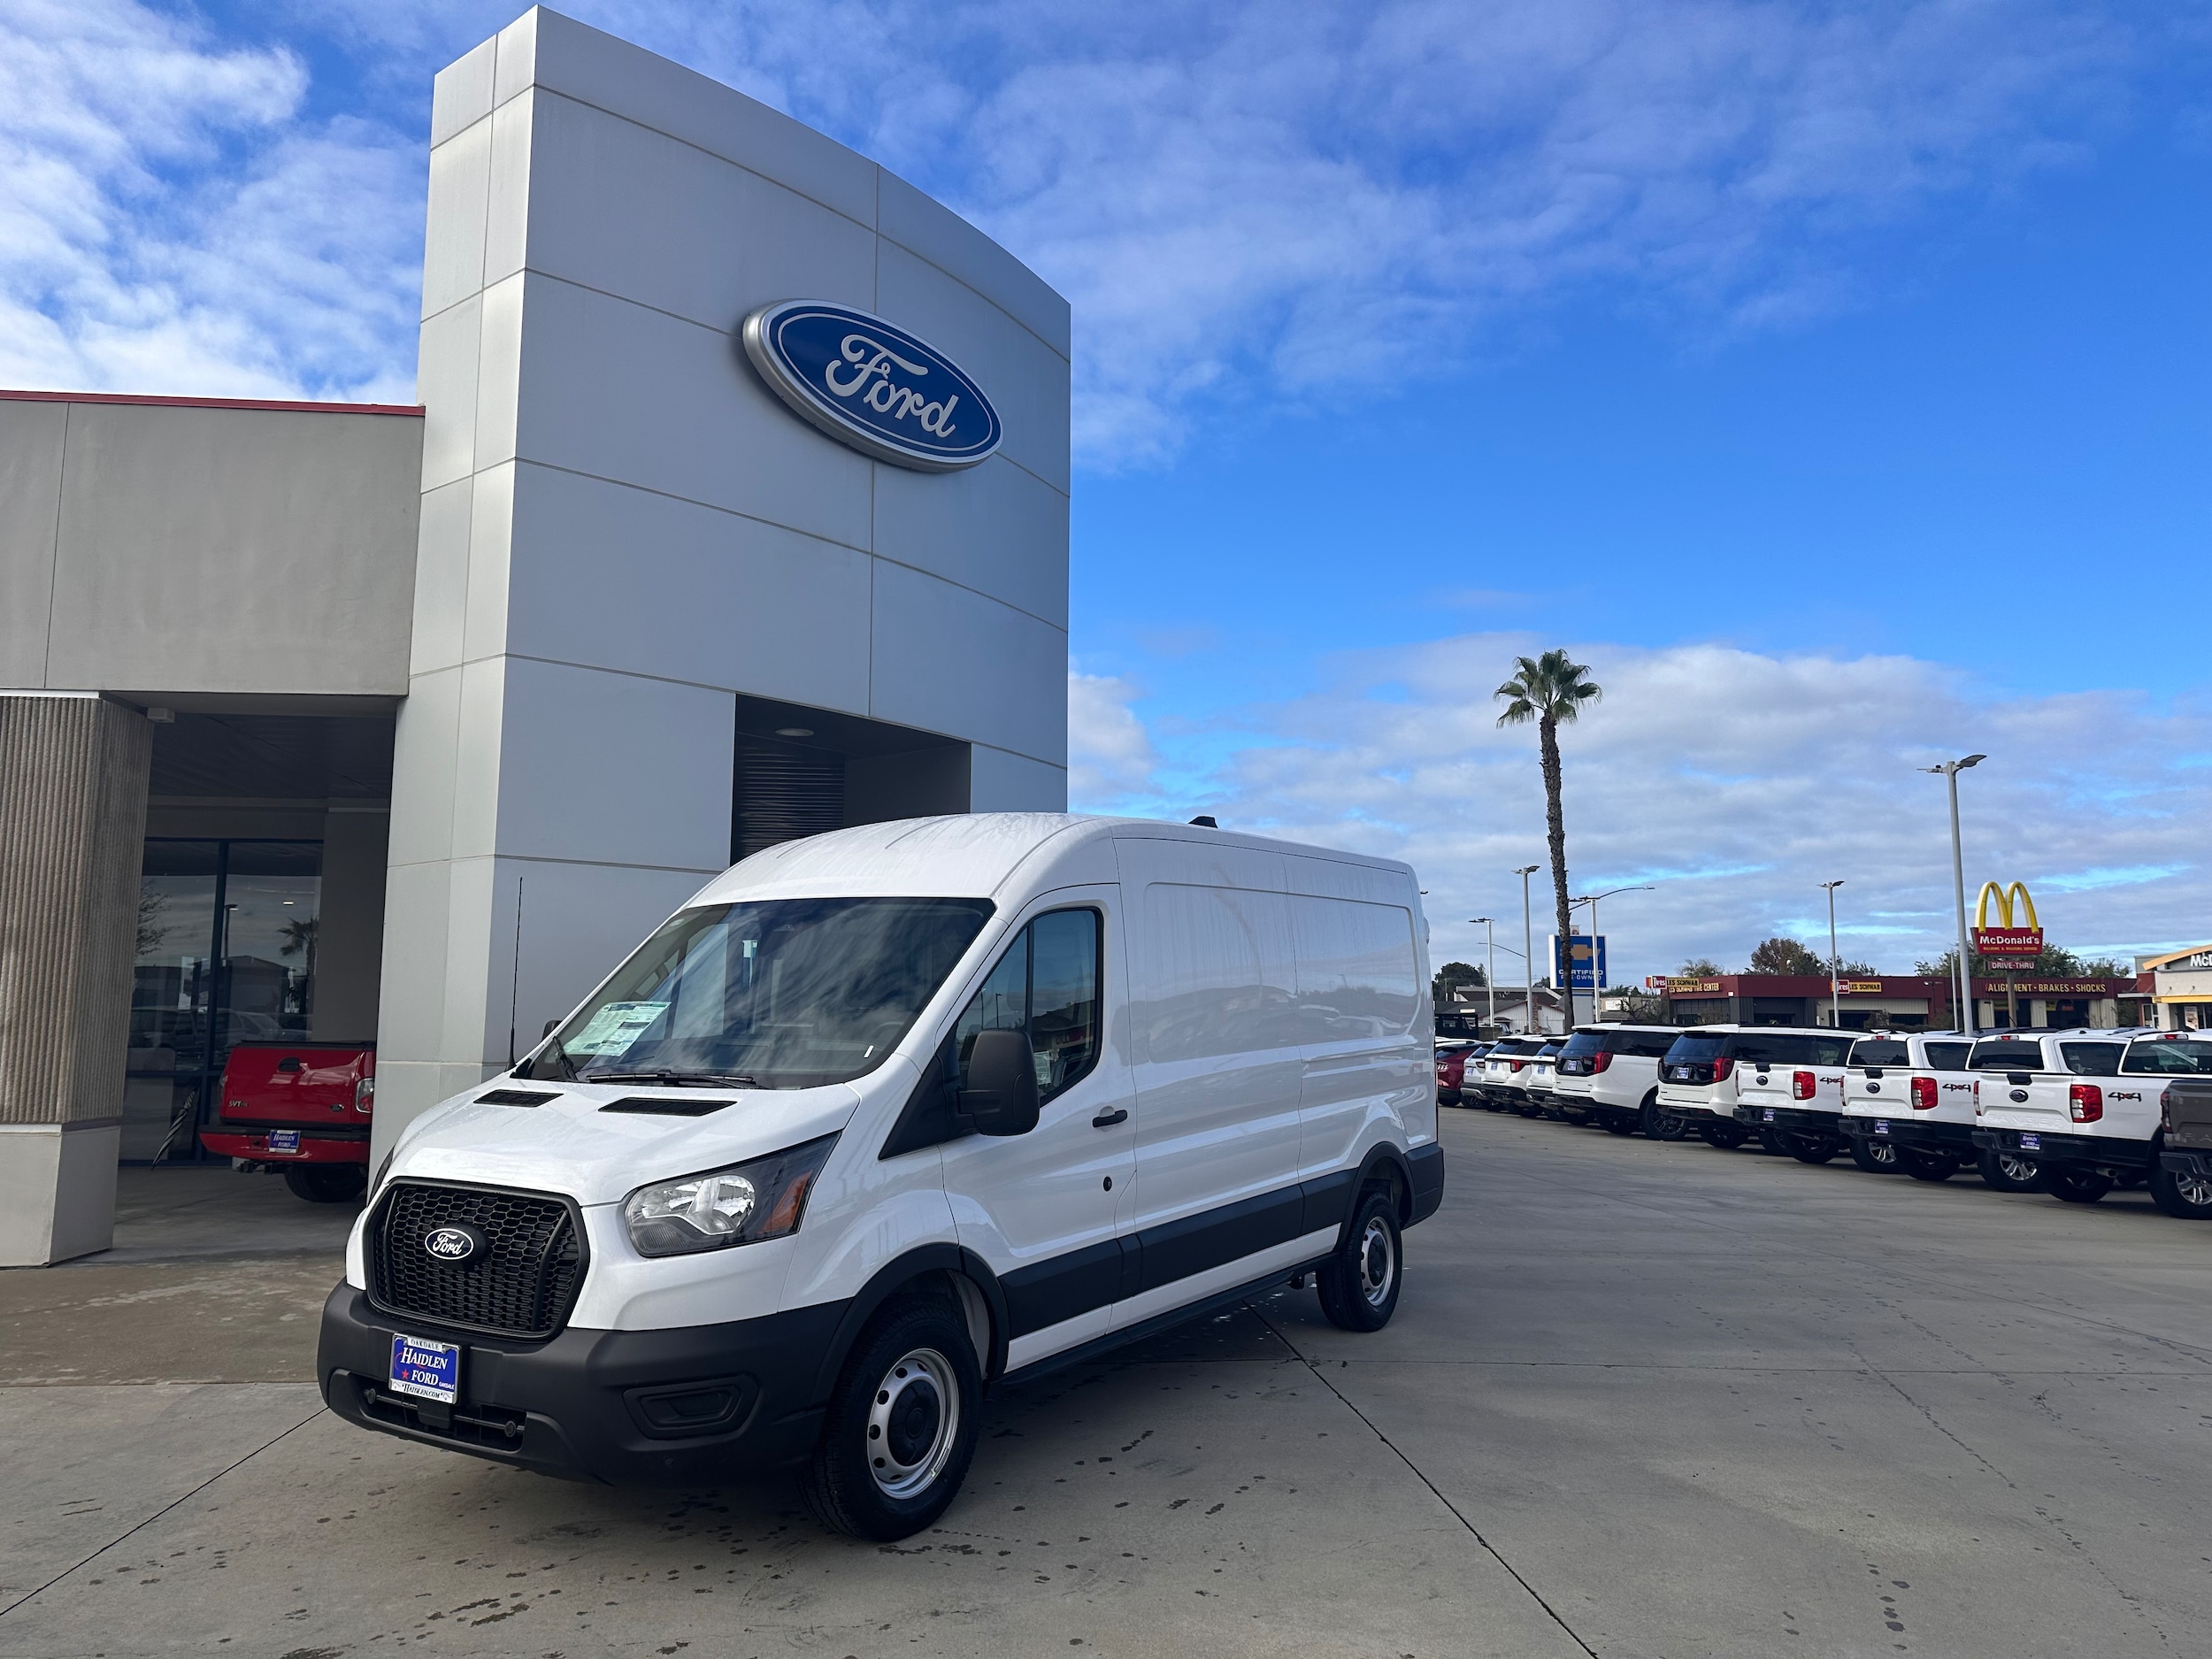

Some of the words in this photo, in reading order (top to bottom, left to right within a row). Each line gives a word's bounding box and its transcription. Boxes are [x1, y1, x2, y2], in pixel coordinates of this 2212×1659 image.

[826, 334, 959, 438] Ford
[1979, 936, 2040, 945] McDonald's
[1653, 977, 1666, 987] Tires
[1704, 983, 1719, 992] CENTER
[2038, 983, 2070, 992] BRAKES
[2076, 983, 2107, 992] SHOCKS
[432, 1232, 465, 1255] Ford
[411, 1339, 440, 1351] OAKDALE
[400, 1347, 448, 1370] HAIDLEN
[411, 1369, 439, 1386] FORD
